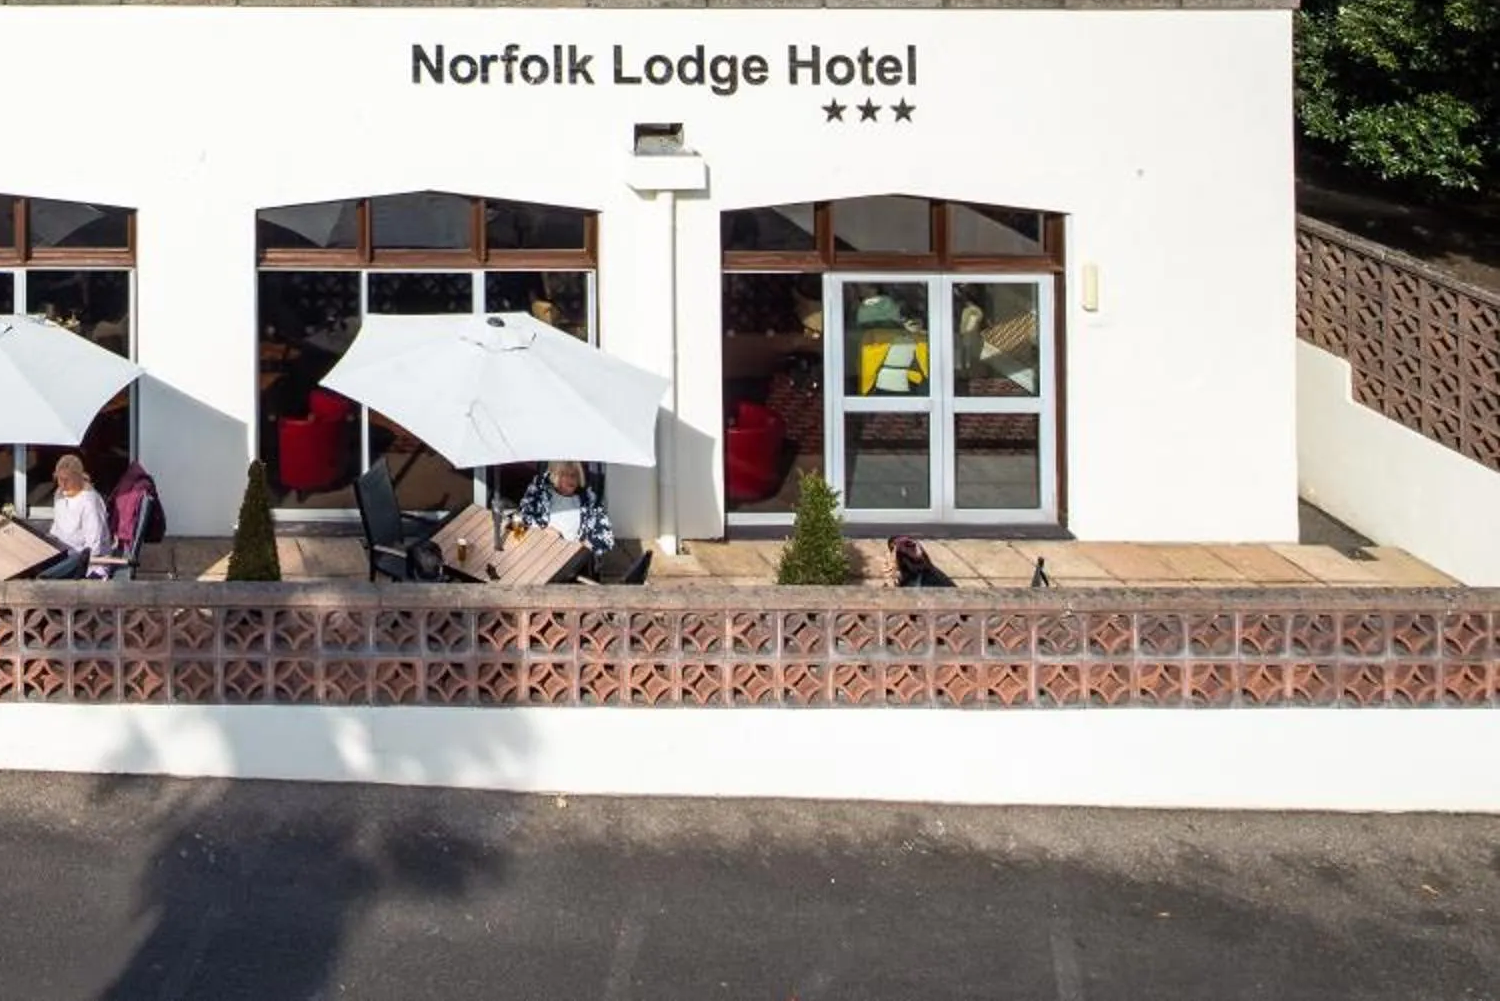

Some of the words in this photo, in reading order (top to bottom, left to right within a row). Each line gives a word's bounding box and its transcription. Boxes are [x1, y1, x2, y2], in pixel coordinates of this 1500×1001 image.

[412, 43, 595, 85] Norfolk
[613, 44, 769, 96] Lodge
[788, 44, 917, 86] Hotel
